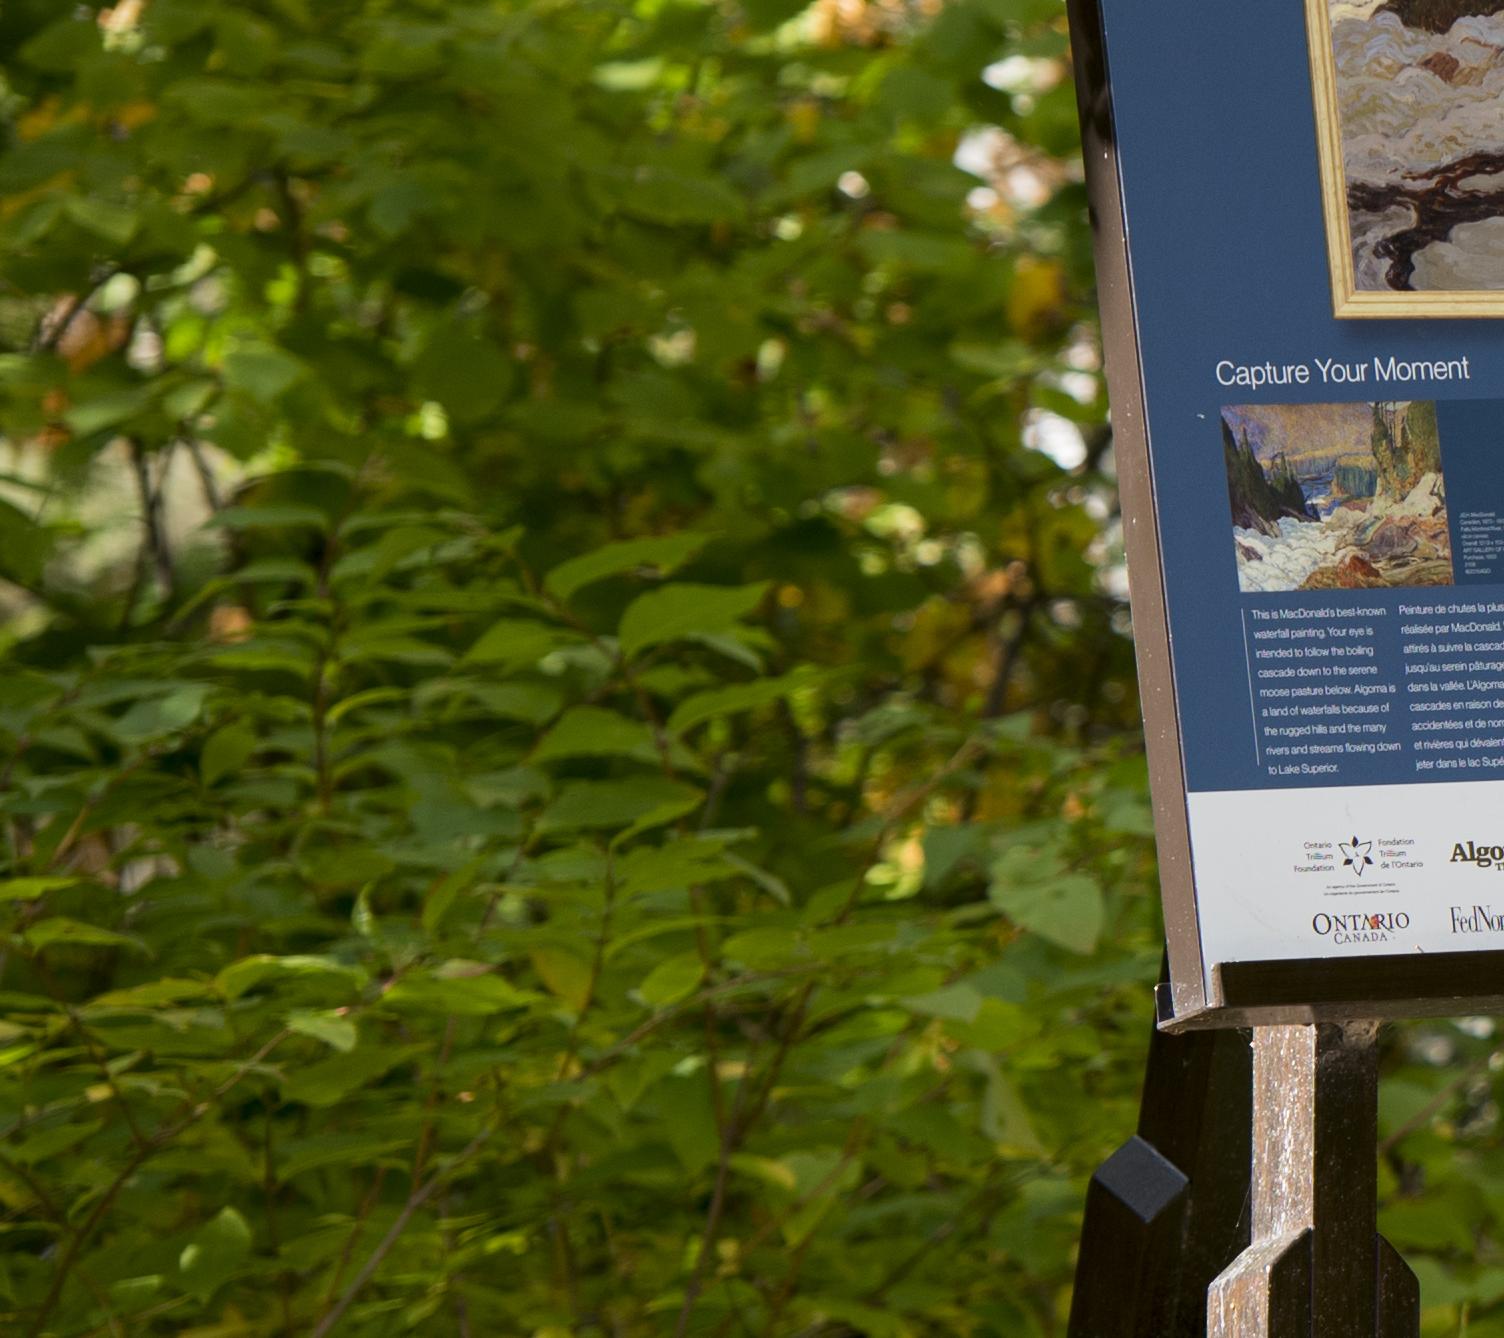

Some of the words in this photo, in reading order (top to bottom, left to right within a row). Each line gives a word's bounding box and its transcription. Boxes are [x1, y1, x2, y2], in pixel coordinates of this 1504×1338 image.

[1216, 361, 1309, 390] Capture
[1314, 358, 1367, 383] Your
[1374, 357, 1470, 381] Moment
[1251, 610, 1270, 620] This
[1271, 610, 1279, 619] is
[1279, 608, 1335, 619] MacDonald's
[1336, 607, 1386, 617] best-known
[1268, 766, 1277, 775] to
[1278, 764, 1300, 775] Lake
[1301, 763, 1339, 775] Superior.
[1378, 838, 1414, 846] Fondation
[1305, 852, 1334, 860] Trum
[1379, 849, 1407, 858] Trum
[1312, 912, 1410, 935] ONTARIO
[1334, 932, 1388, 944] CANADA
